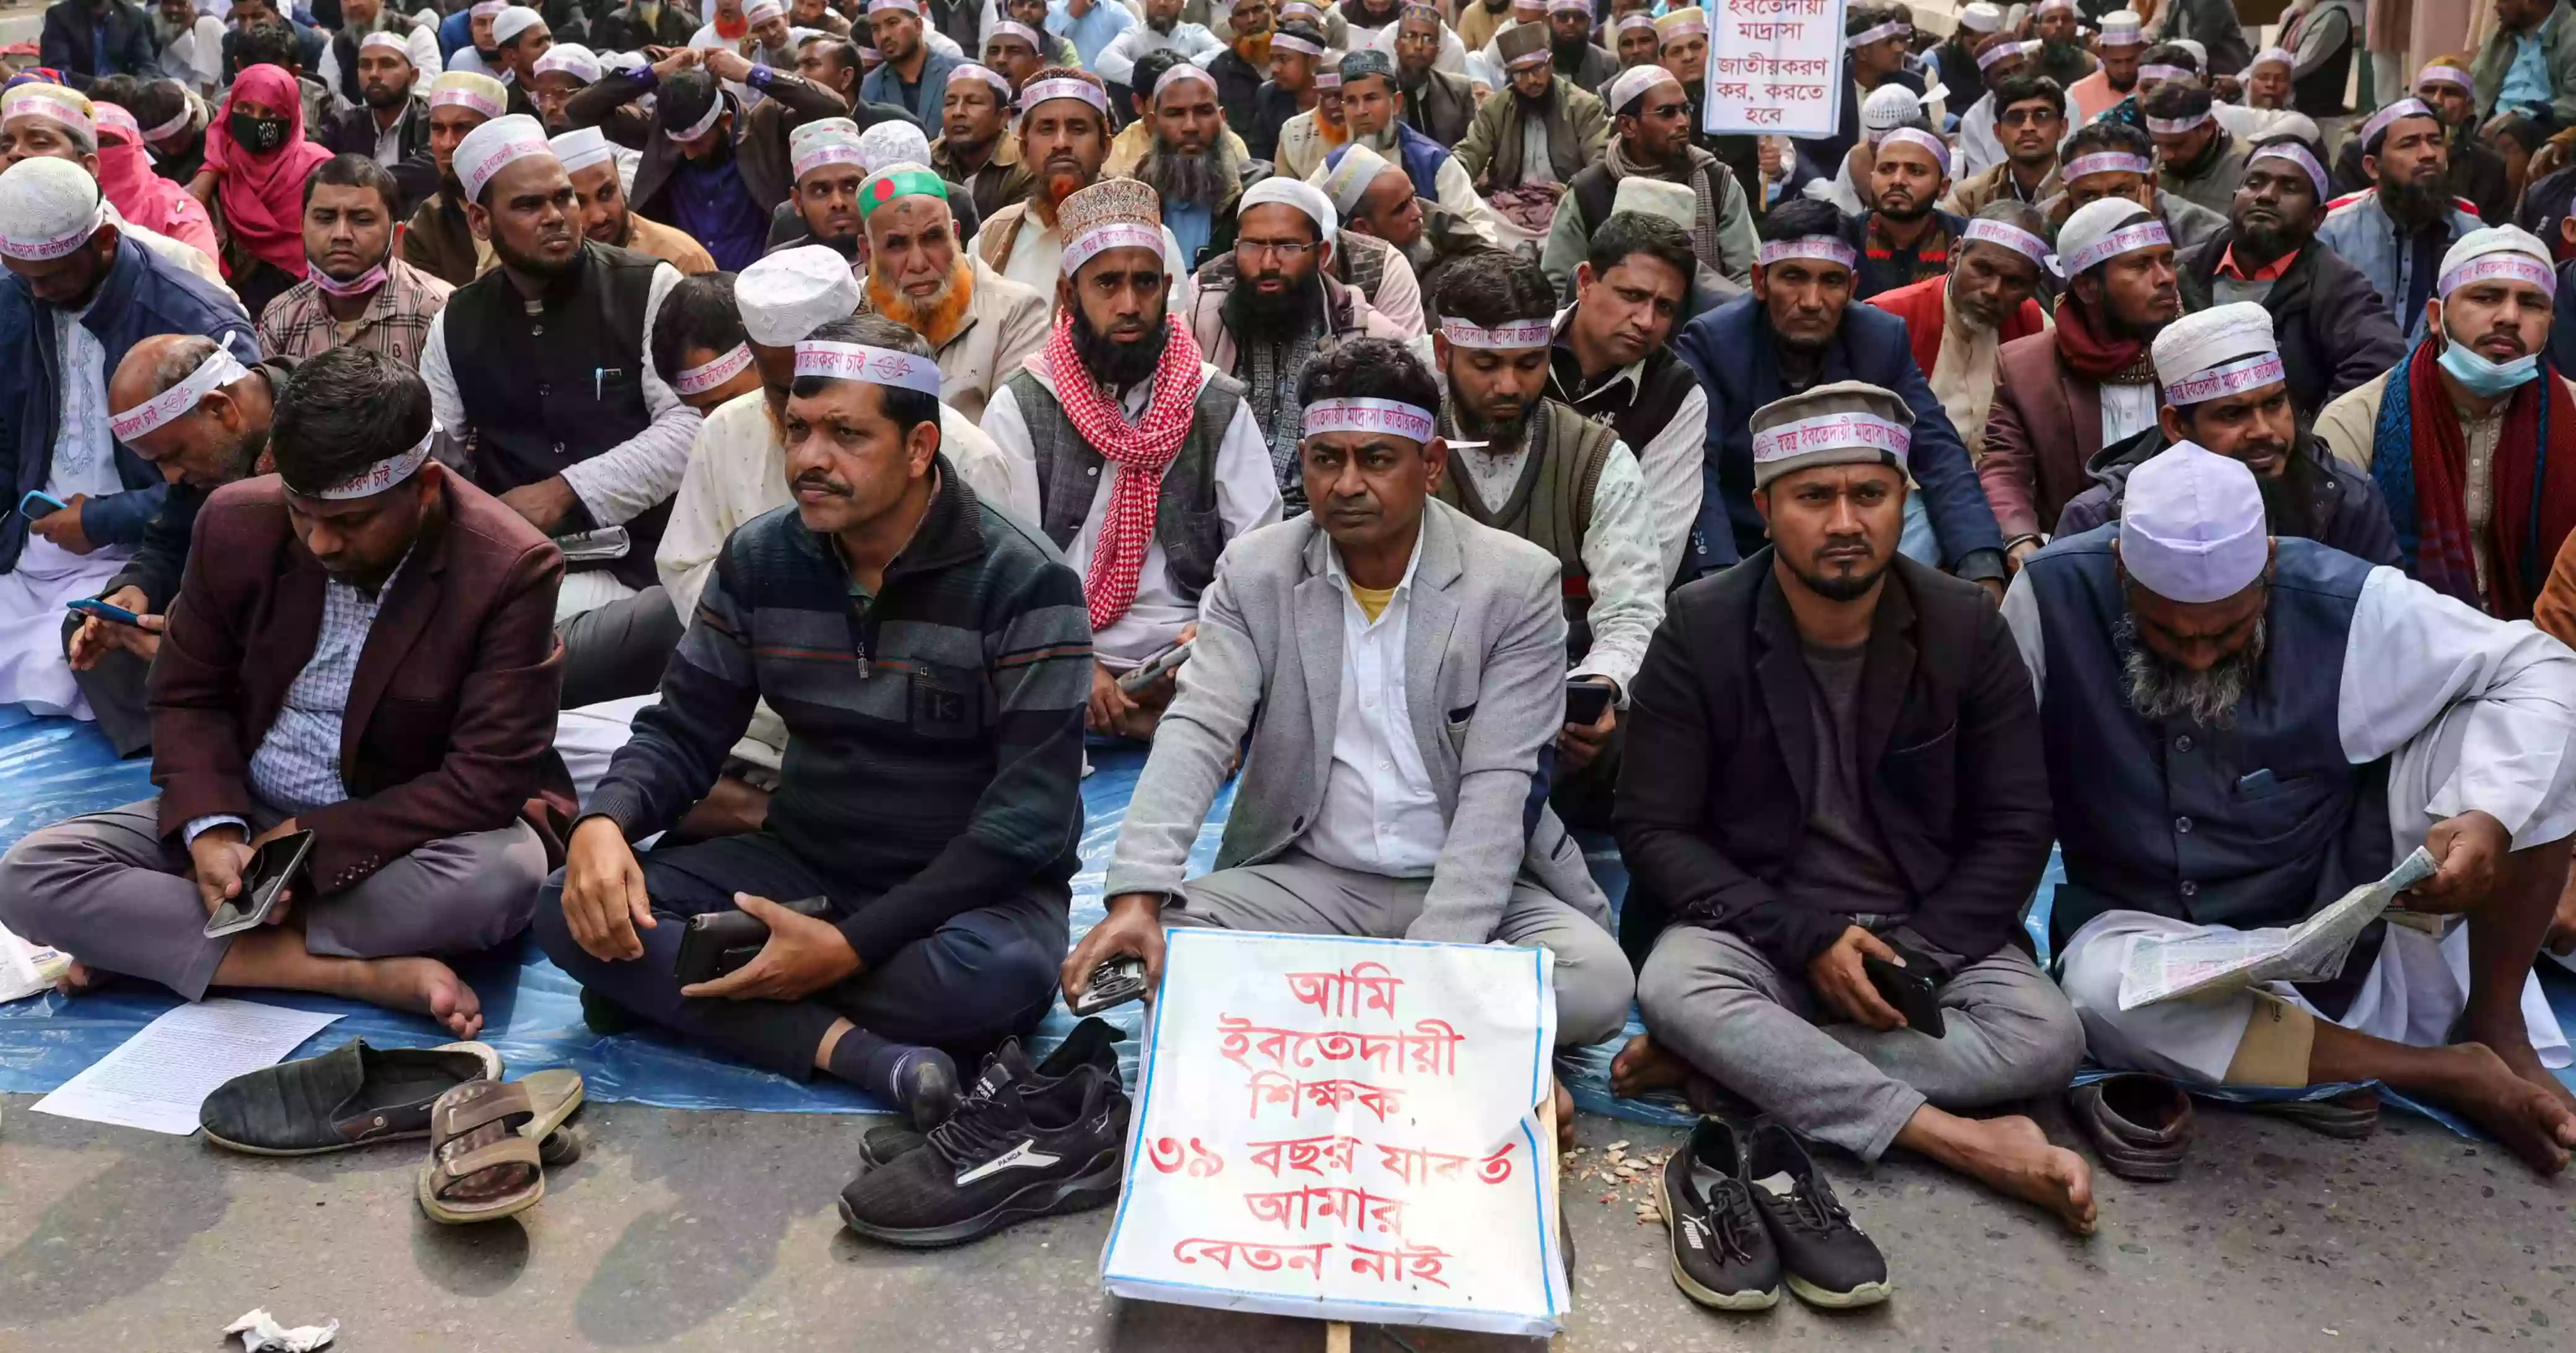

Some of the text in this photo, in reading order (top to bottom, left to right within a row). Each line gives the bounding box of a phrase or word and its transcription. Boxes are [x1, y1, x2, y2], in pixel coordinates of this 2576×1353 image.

[1737, 22, 1804, 42] মাদ্রাসা
[1716, 52, 1829, 77] জাতীয়করণ
[1716, 82, 1827, 102] কর, করতে
[1744, 107, 1784, 126] হবে
[847, 349, 867, 377] চাই
[1799, 415, 1852, 447] ইবতেদায়ী
[1853, 421, 1885, 444] মাদ্রাসা
[373, 465, 391, 488] চাই
[1285, 961, 1406, 1020] আমি
[1216, 1011, 1465, 1076] ইবতেদায়ী
[1244, 1068, 1407, 1124] শিক্ষক
[1145, 1137, 1225, 1178] ৩৯
[1246, 1134, 1363, 1178] বছর
[1242, 1184, 1411, 1237] আমার
[1172, 1237, 1456, 1289] বেতন নাই
